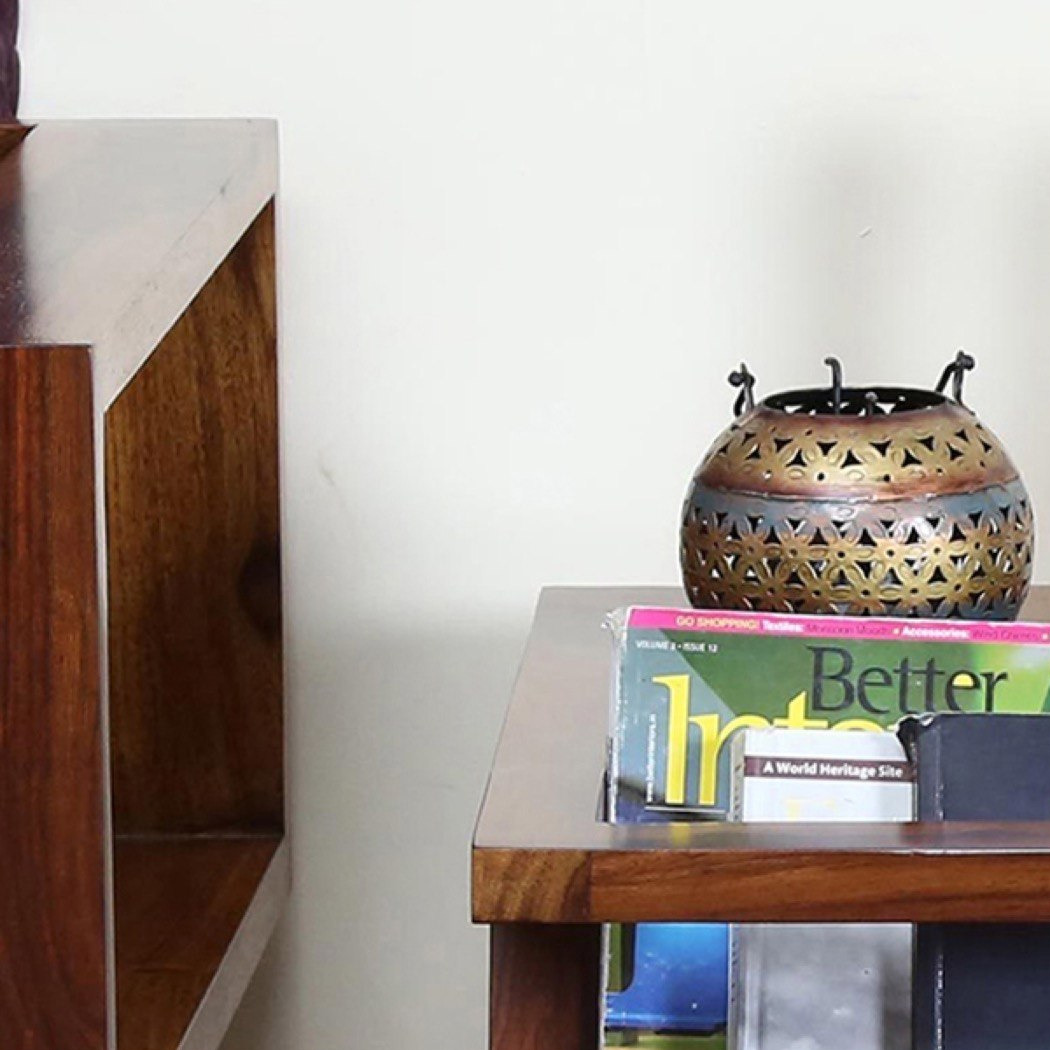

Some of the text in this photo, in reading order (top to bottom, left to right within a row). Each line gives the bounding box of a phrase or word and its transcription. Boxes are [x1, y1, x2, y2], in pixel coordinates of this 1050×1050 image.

[676, 615, 695, 628] GO
[635, 639, 669, 651] VOLUME
[683, 642, 705, 652] ISSUE
[807, 645, 1008, 715] Better
[762, 761, 904, 780] A World Heritage Site
